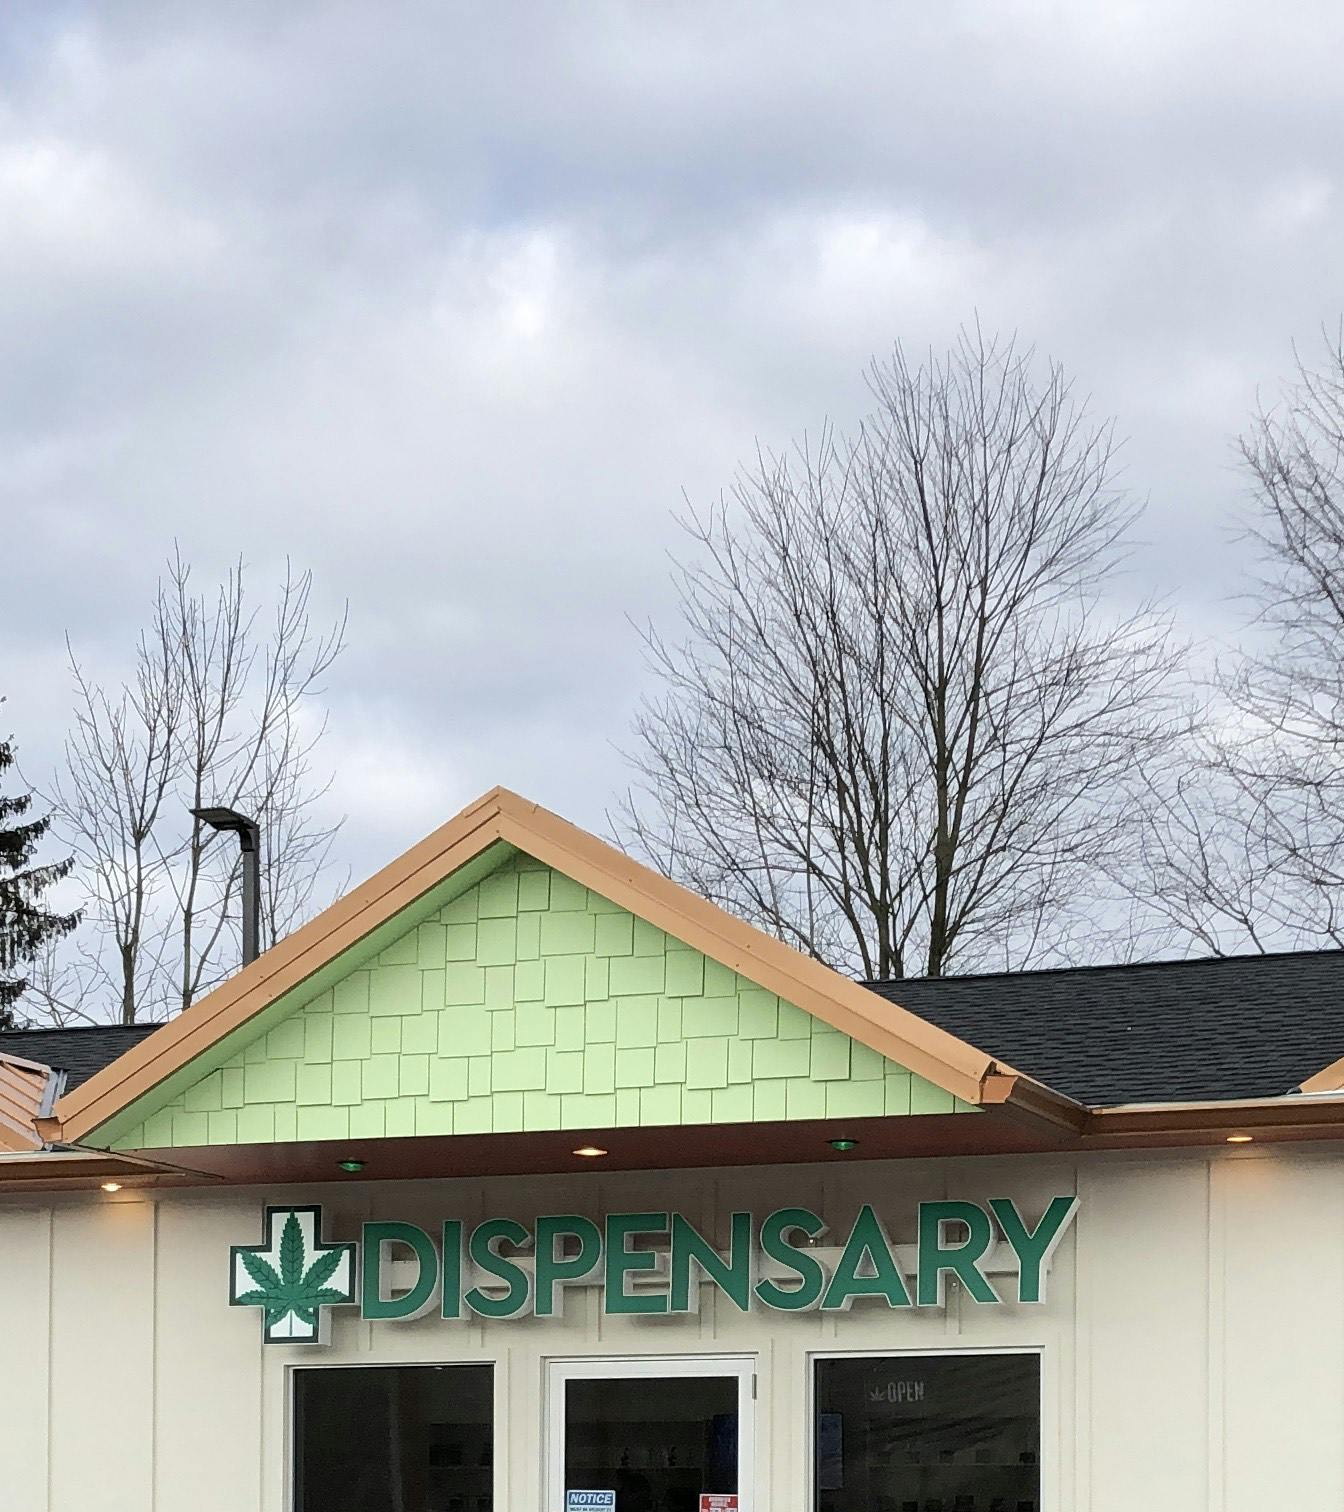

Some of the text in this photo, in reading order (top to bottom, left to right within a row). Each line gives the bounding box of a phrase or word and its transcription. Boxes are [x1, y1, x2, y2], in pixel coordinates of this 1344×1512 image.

[361, 1196, 1080, 1320] DISPENSARY
[887, 1381, 924, 1402] OPEN
[570, 1493, 613, 1504] NOTICE
